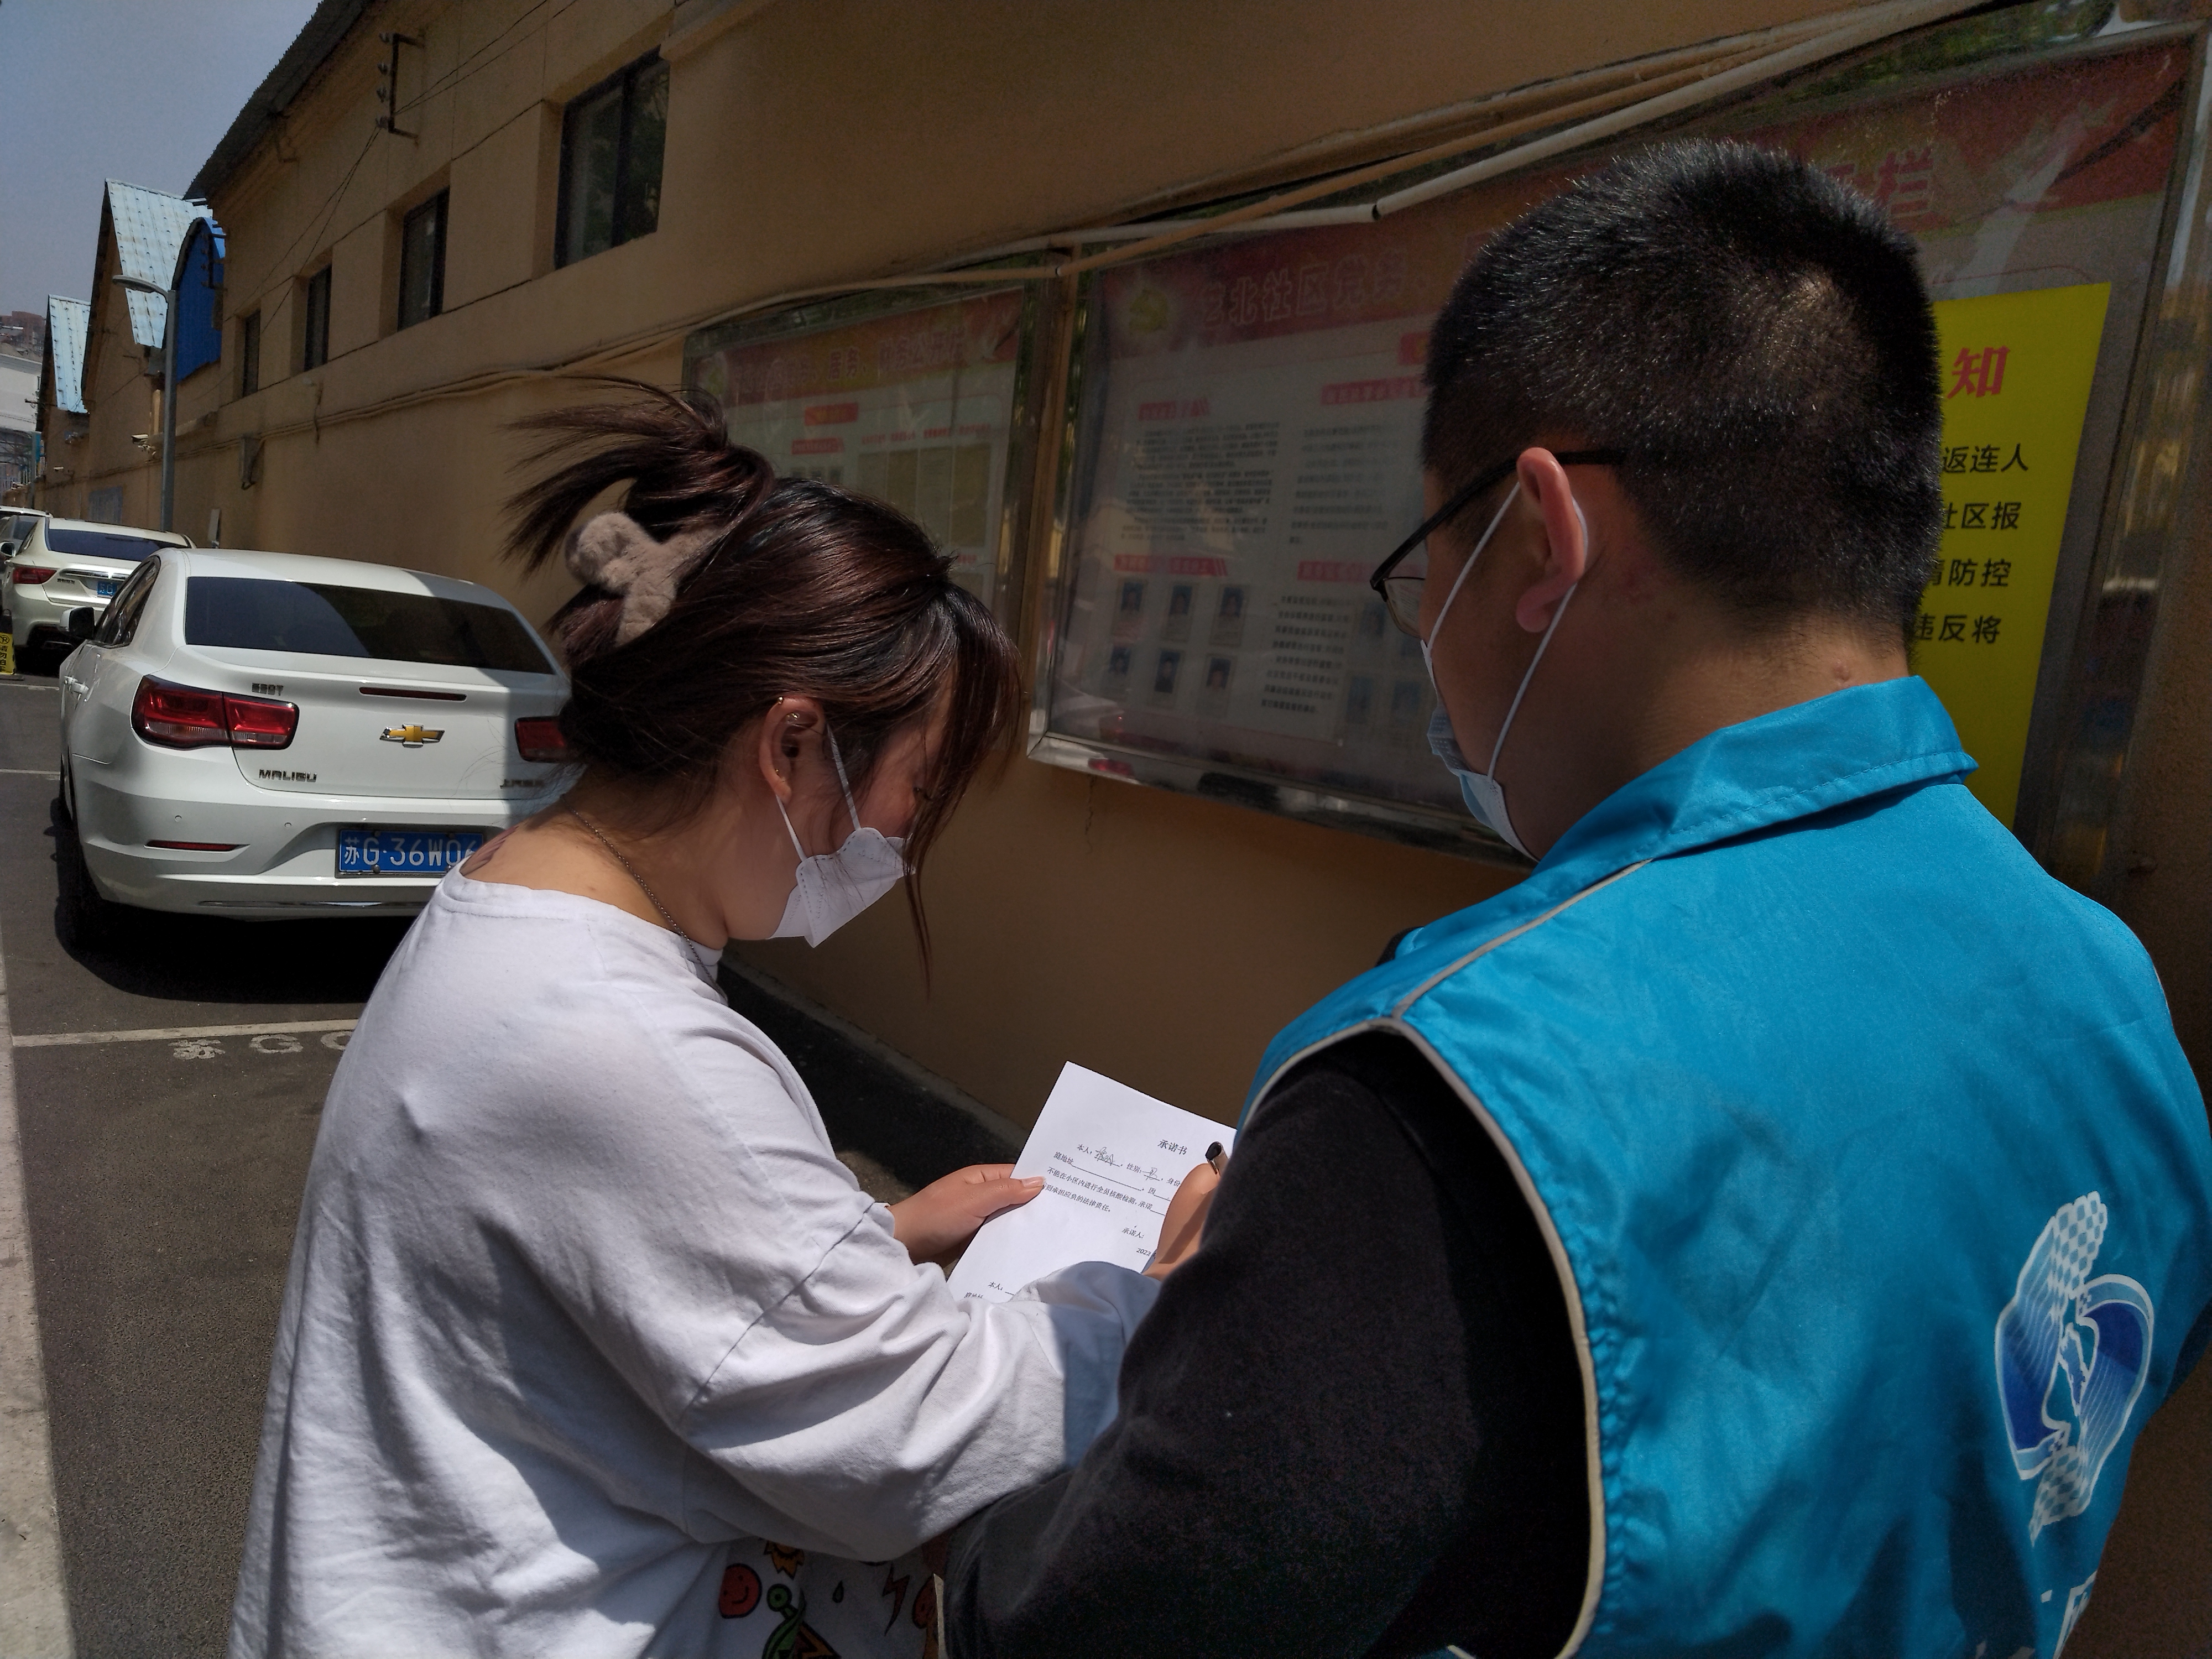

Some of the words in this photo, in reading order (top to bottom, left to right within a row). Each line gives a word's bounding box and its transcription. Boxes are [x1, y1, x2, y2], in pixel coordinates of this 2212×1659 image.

[1947, 345, 2011, 400] 知
[1942, 442, 2029, 474] 返连人
[258, 769, 318, 783] MALIBU
[1157, 1139, 1188, 1155] 承诺书
